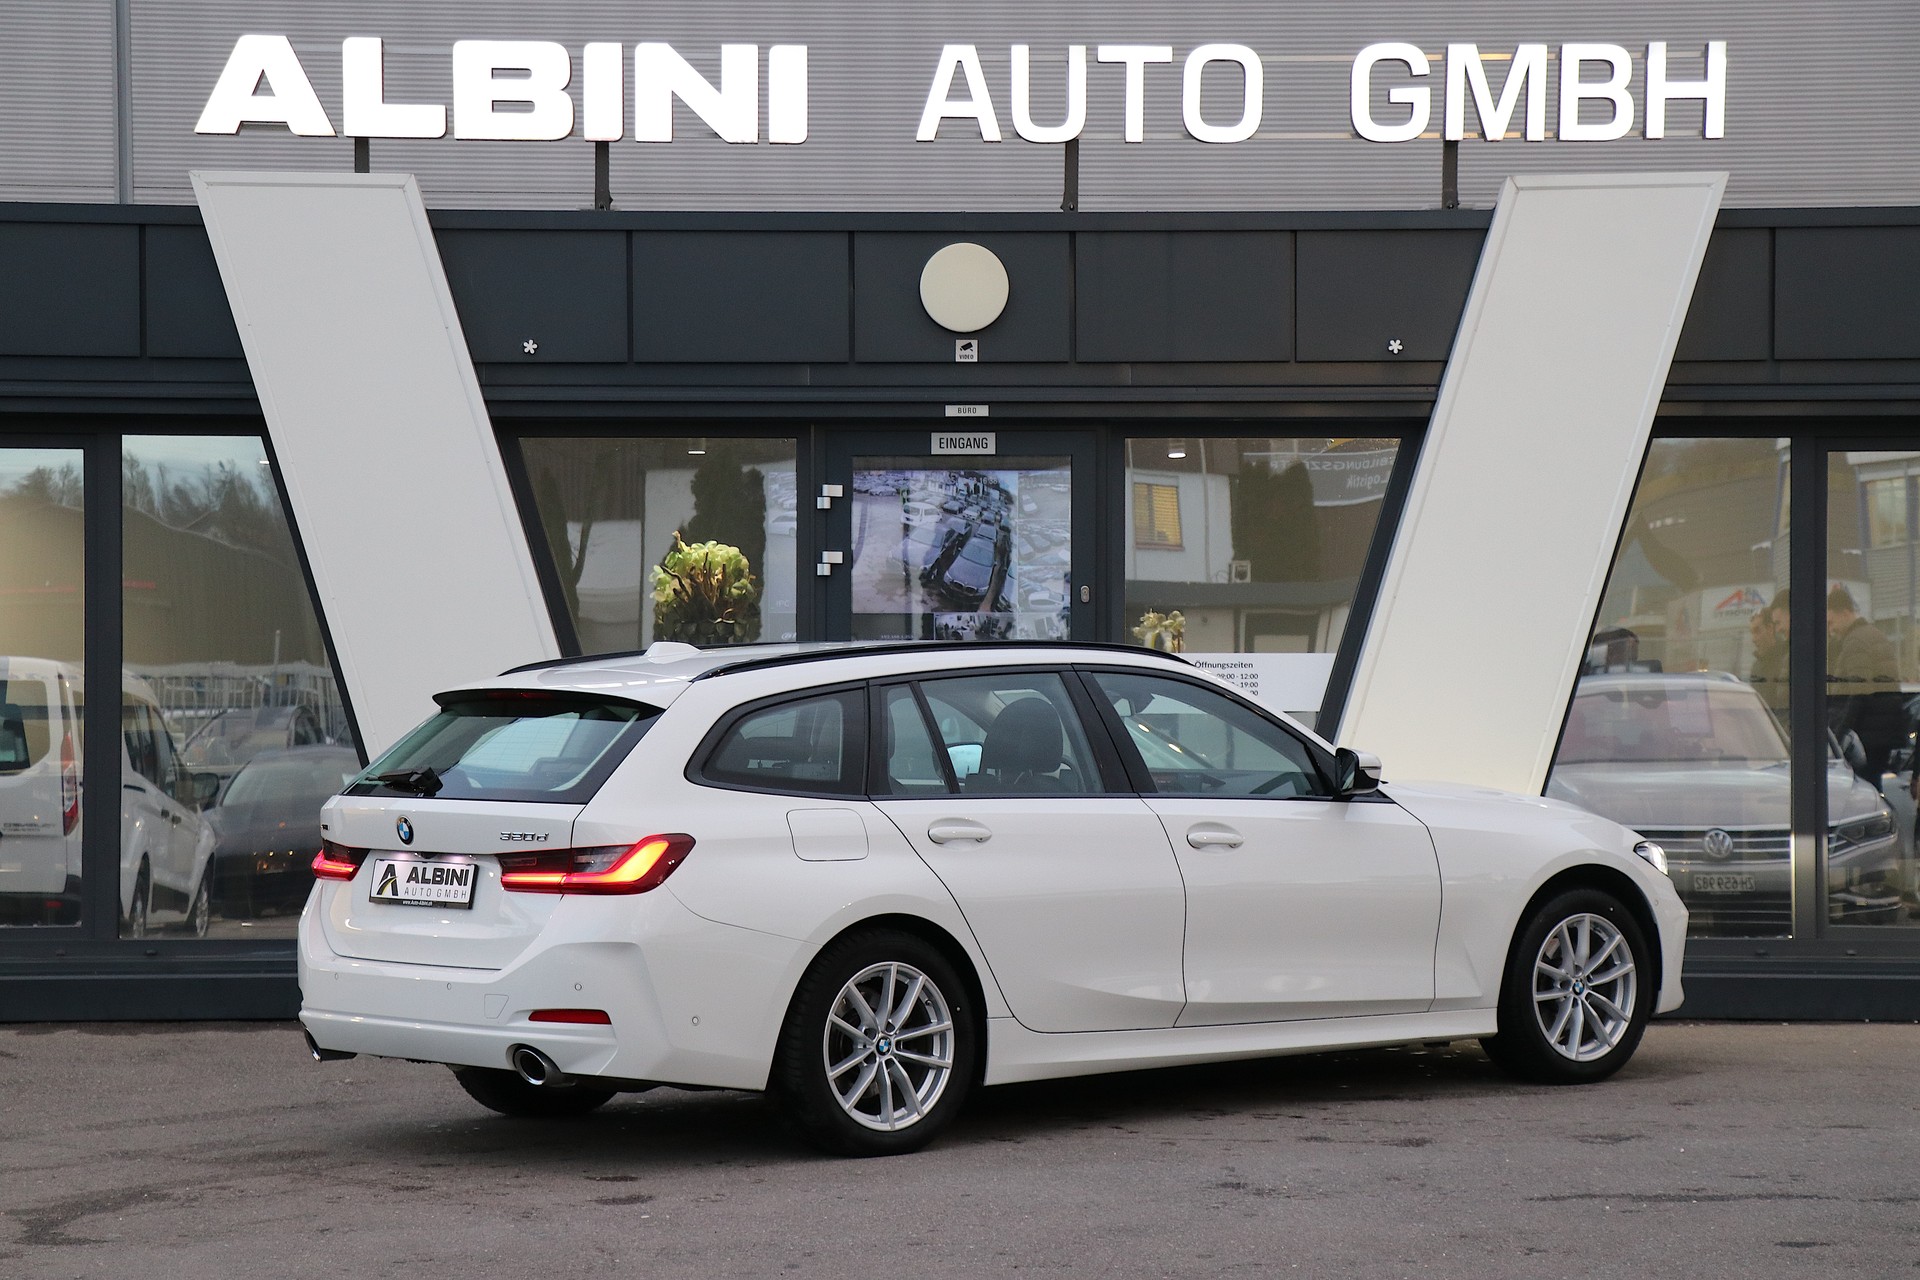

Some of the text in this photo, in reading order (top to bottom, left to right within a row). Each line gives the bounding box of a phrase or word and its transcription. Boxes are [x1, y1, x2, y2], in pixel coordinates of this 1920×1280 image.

[194, 34, 1727, 144] ALBINI AUTO GMBH
[957, 405, 977, 414] BÜRO
[939, 437, 988, 449] EINGANG
[1194, 660, 1253, 669] Öffnungszeiten
[500, 831, 549, 841] 320d
[406, 866, 470, 887] ALBINI
[404, 887, 467, 899] AUTO GMBH
